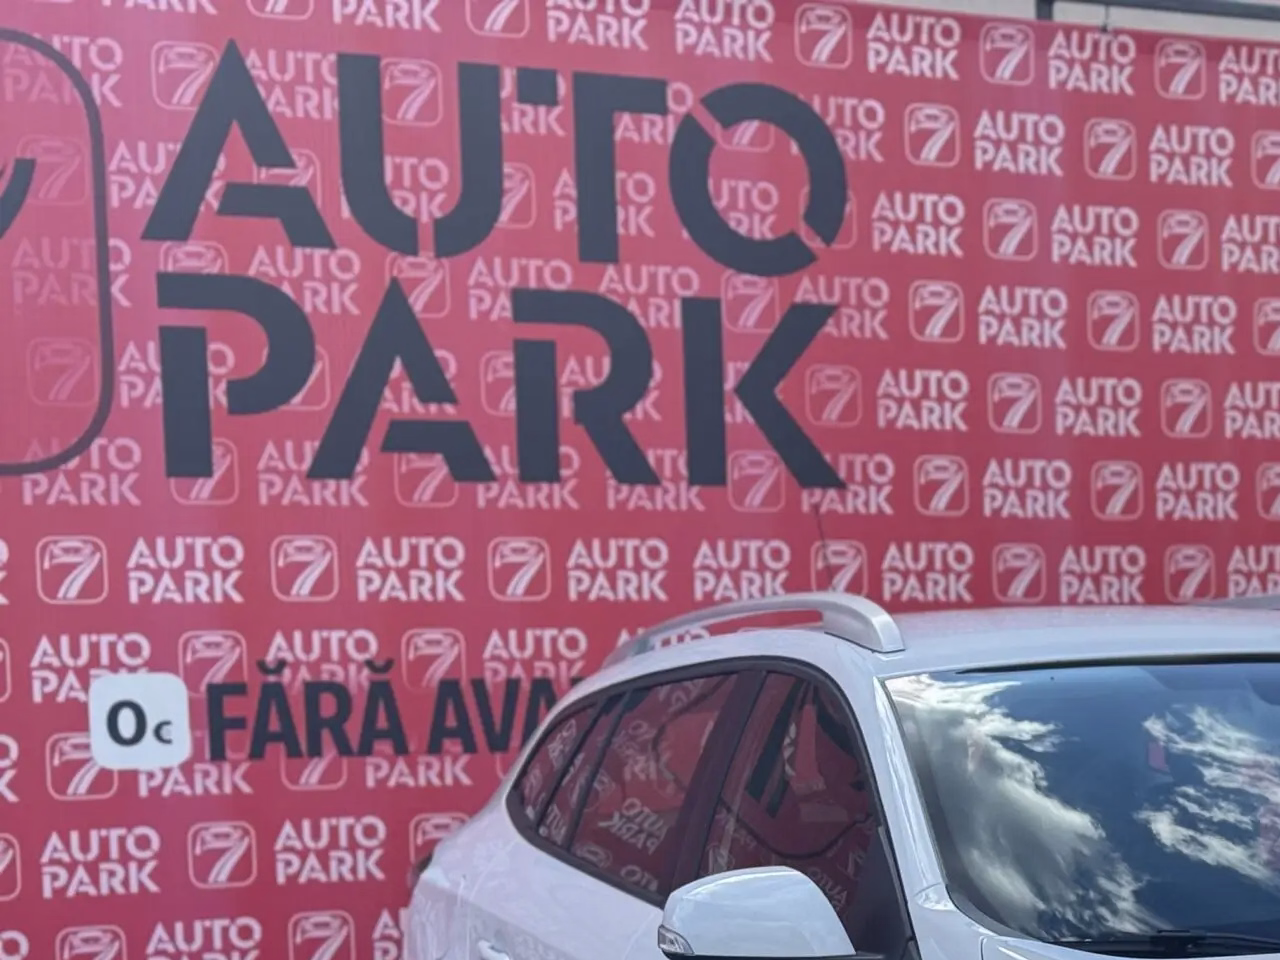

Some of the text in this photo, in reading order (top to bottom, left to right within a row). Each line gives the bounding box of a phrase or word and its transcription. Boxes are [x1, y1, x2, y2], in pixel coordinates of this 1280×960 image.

[547, 10, 649, 50] PARK
[676, 23, 773, 63] PARK
[866, 12, 961, 47] AUTO
[866, 46, 960, 80] PARK
[1049, 29, 1136, 64] AUTO
[1049, 58, 1134, 96] PARK
[812, 93, 885, 129] UTO
[974, 110, 1064, 145] AUTO
[141, 38, 848, 276] AUTO
[1149, 125, 1234, 156] AUTO
[974, 142, 1063, 176] PARK
[1149, 156, 1232, 187] PARK
[872, 192, 965, 225] AUTO
[1051, 205, 1139, 236] AUTO
[873, 223, 963, 258] PARK
[1051, 235, 1137, 268] PARK
[248, 246, 361, 281] AUTO
[468, 258, 572, 291] AUTO
[601, 264, 699, 295] AUTO
[794, 275, 889, 307] AUTO
[978, 285, 1067, 318] AUTO
[822, 304, 888, 339] ARK
[1153, 296, 1237, 324] AUTO
[978, 316, 1065, 349] PARK
[1153, 324, 1235, 354] PARK
[157, 272, 846, 486] PARK
[877, 369, 969, 399] AUTO
[1056, 377, 1141, 407] AUTO
[878, 399, 967, 432] PARK
[1056, 405, 1141, 437] PARK
[22, 473, 142, 506] PARK
[258, 472, 368, 505] PARK
[982, 459, 1071, 489] AUTO
[1156, 462, 1239, 492] AUTO
[477, 480, 580, 510] PARK
[607, 485, 705, 512] PARK
[983, 487, 1070, 520] PARK
[1156, 492, 1238, 521] PARK
[127, 536, 243, 569] AUTO
[356, 536, 465, 569] AUTO
[567, 538, 669, 570] AUTO
[694, 539, 790, 570] AUTO
[883, 542, 974, 571] AUTO
[1060, 545, 1145, 573] AUTO
[128, 571, 243, 603] PARK
[357, 570, 465, 601] PARK
[568, 570, 668, 601] PARK
[694, 570, 788, 599] PARK
[883, 571, 973, 602] PARK
[1060, 574, 1144, 604] PARK
[30, 633, 151, 667] AUTO
[266, 630, 378, 662] AUTO
[483, 629, 588, 659] AUTO
[205, 659, 409, 761] FĂRĂ
[428, 677, 587, 754] AVA
[366, 755, 473, 788] PARK
[40, 826, 160, 862] AUTO
[274, 816, 386, 850] AUTO
[41, 860, 160, 898] PARK
[276, 849, 385, 885] PARK
[146, 917, 262, 954] AUTO
